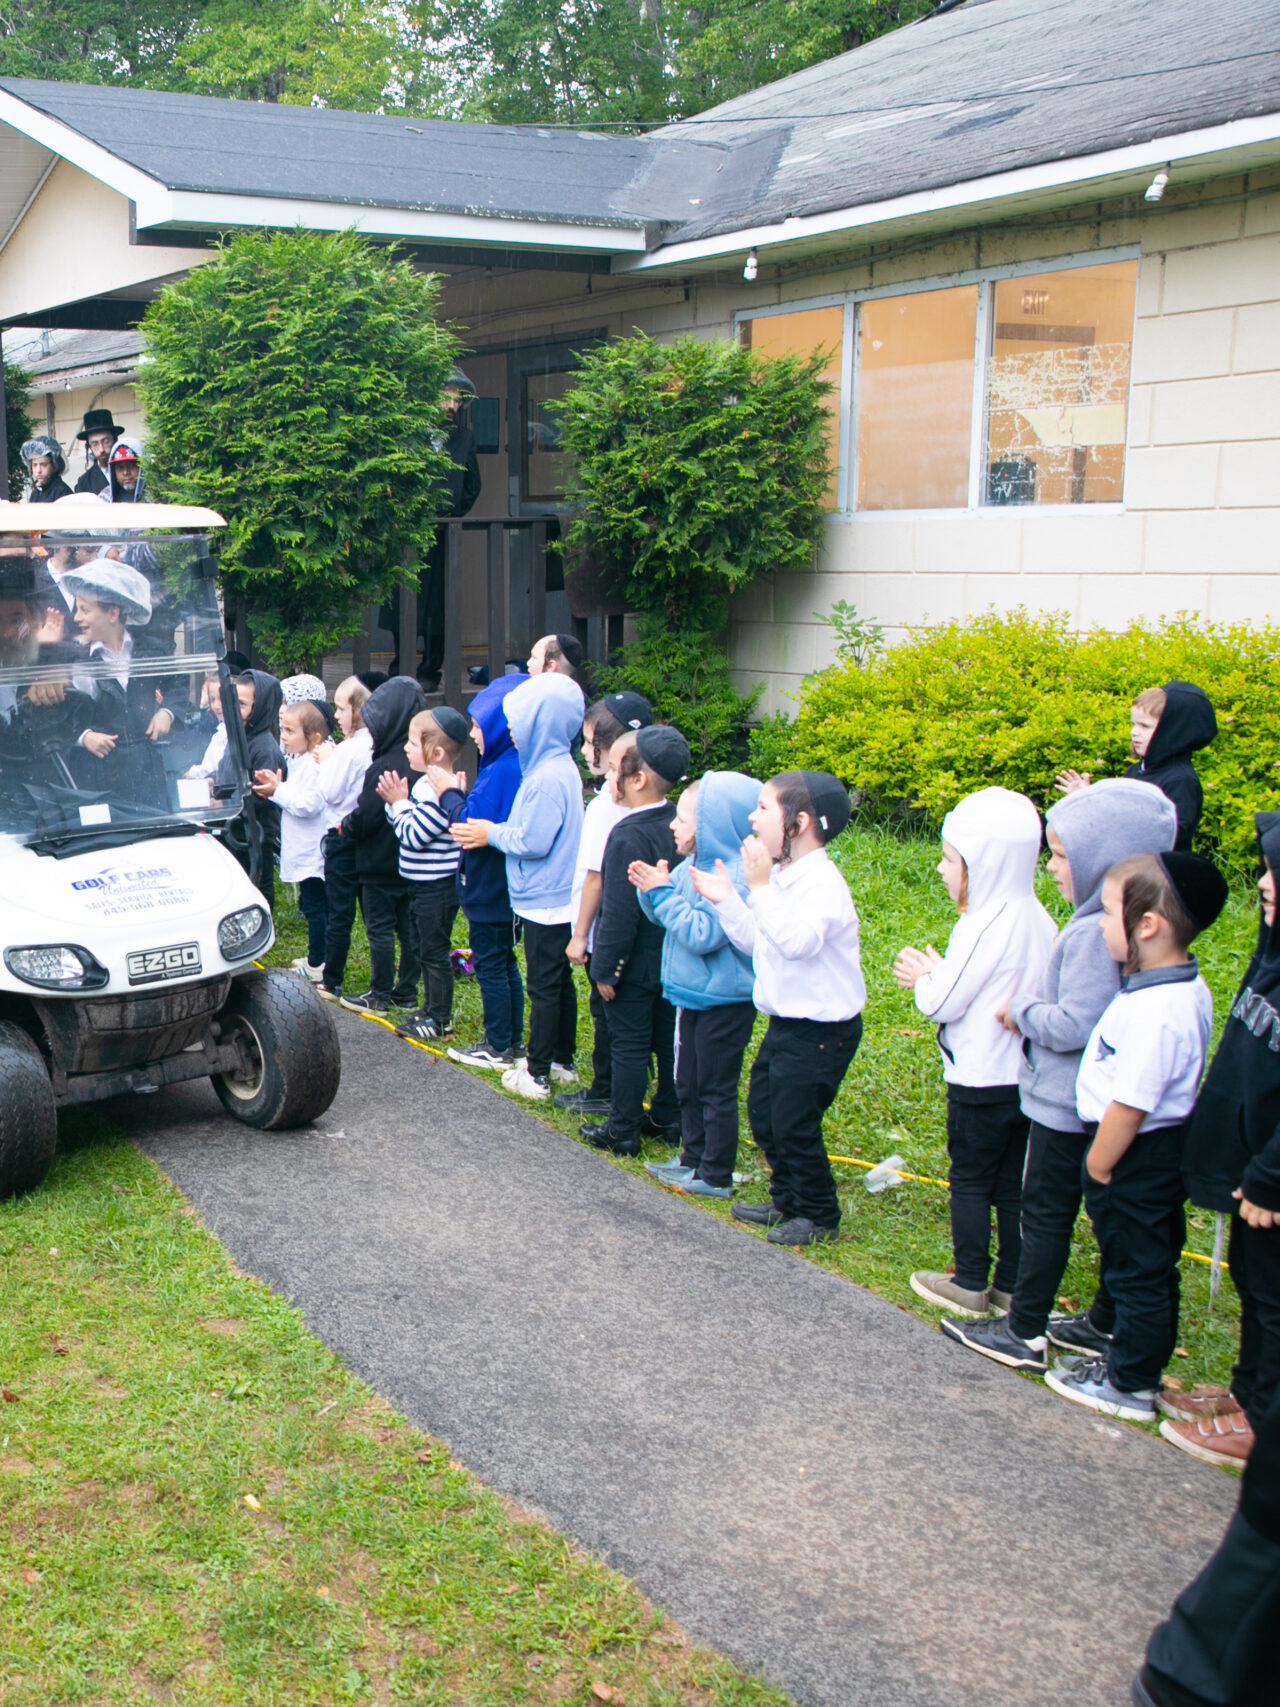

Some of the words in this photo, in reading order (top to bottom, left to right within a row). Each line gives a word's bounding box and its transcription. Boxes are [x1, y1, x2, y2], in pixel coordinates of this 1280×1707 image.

[1023, 289, 1048, 315] EXIT
[71, 874, 119, 891] GOLF
[123, 867, 172, 880] CARS
